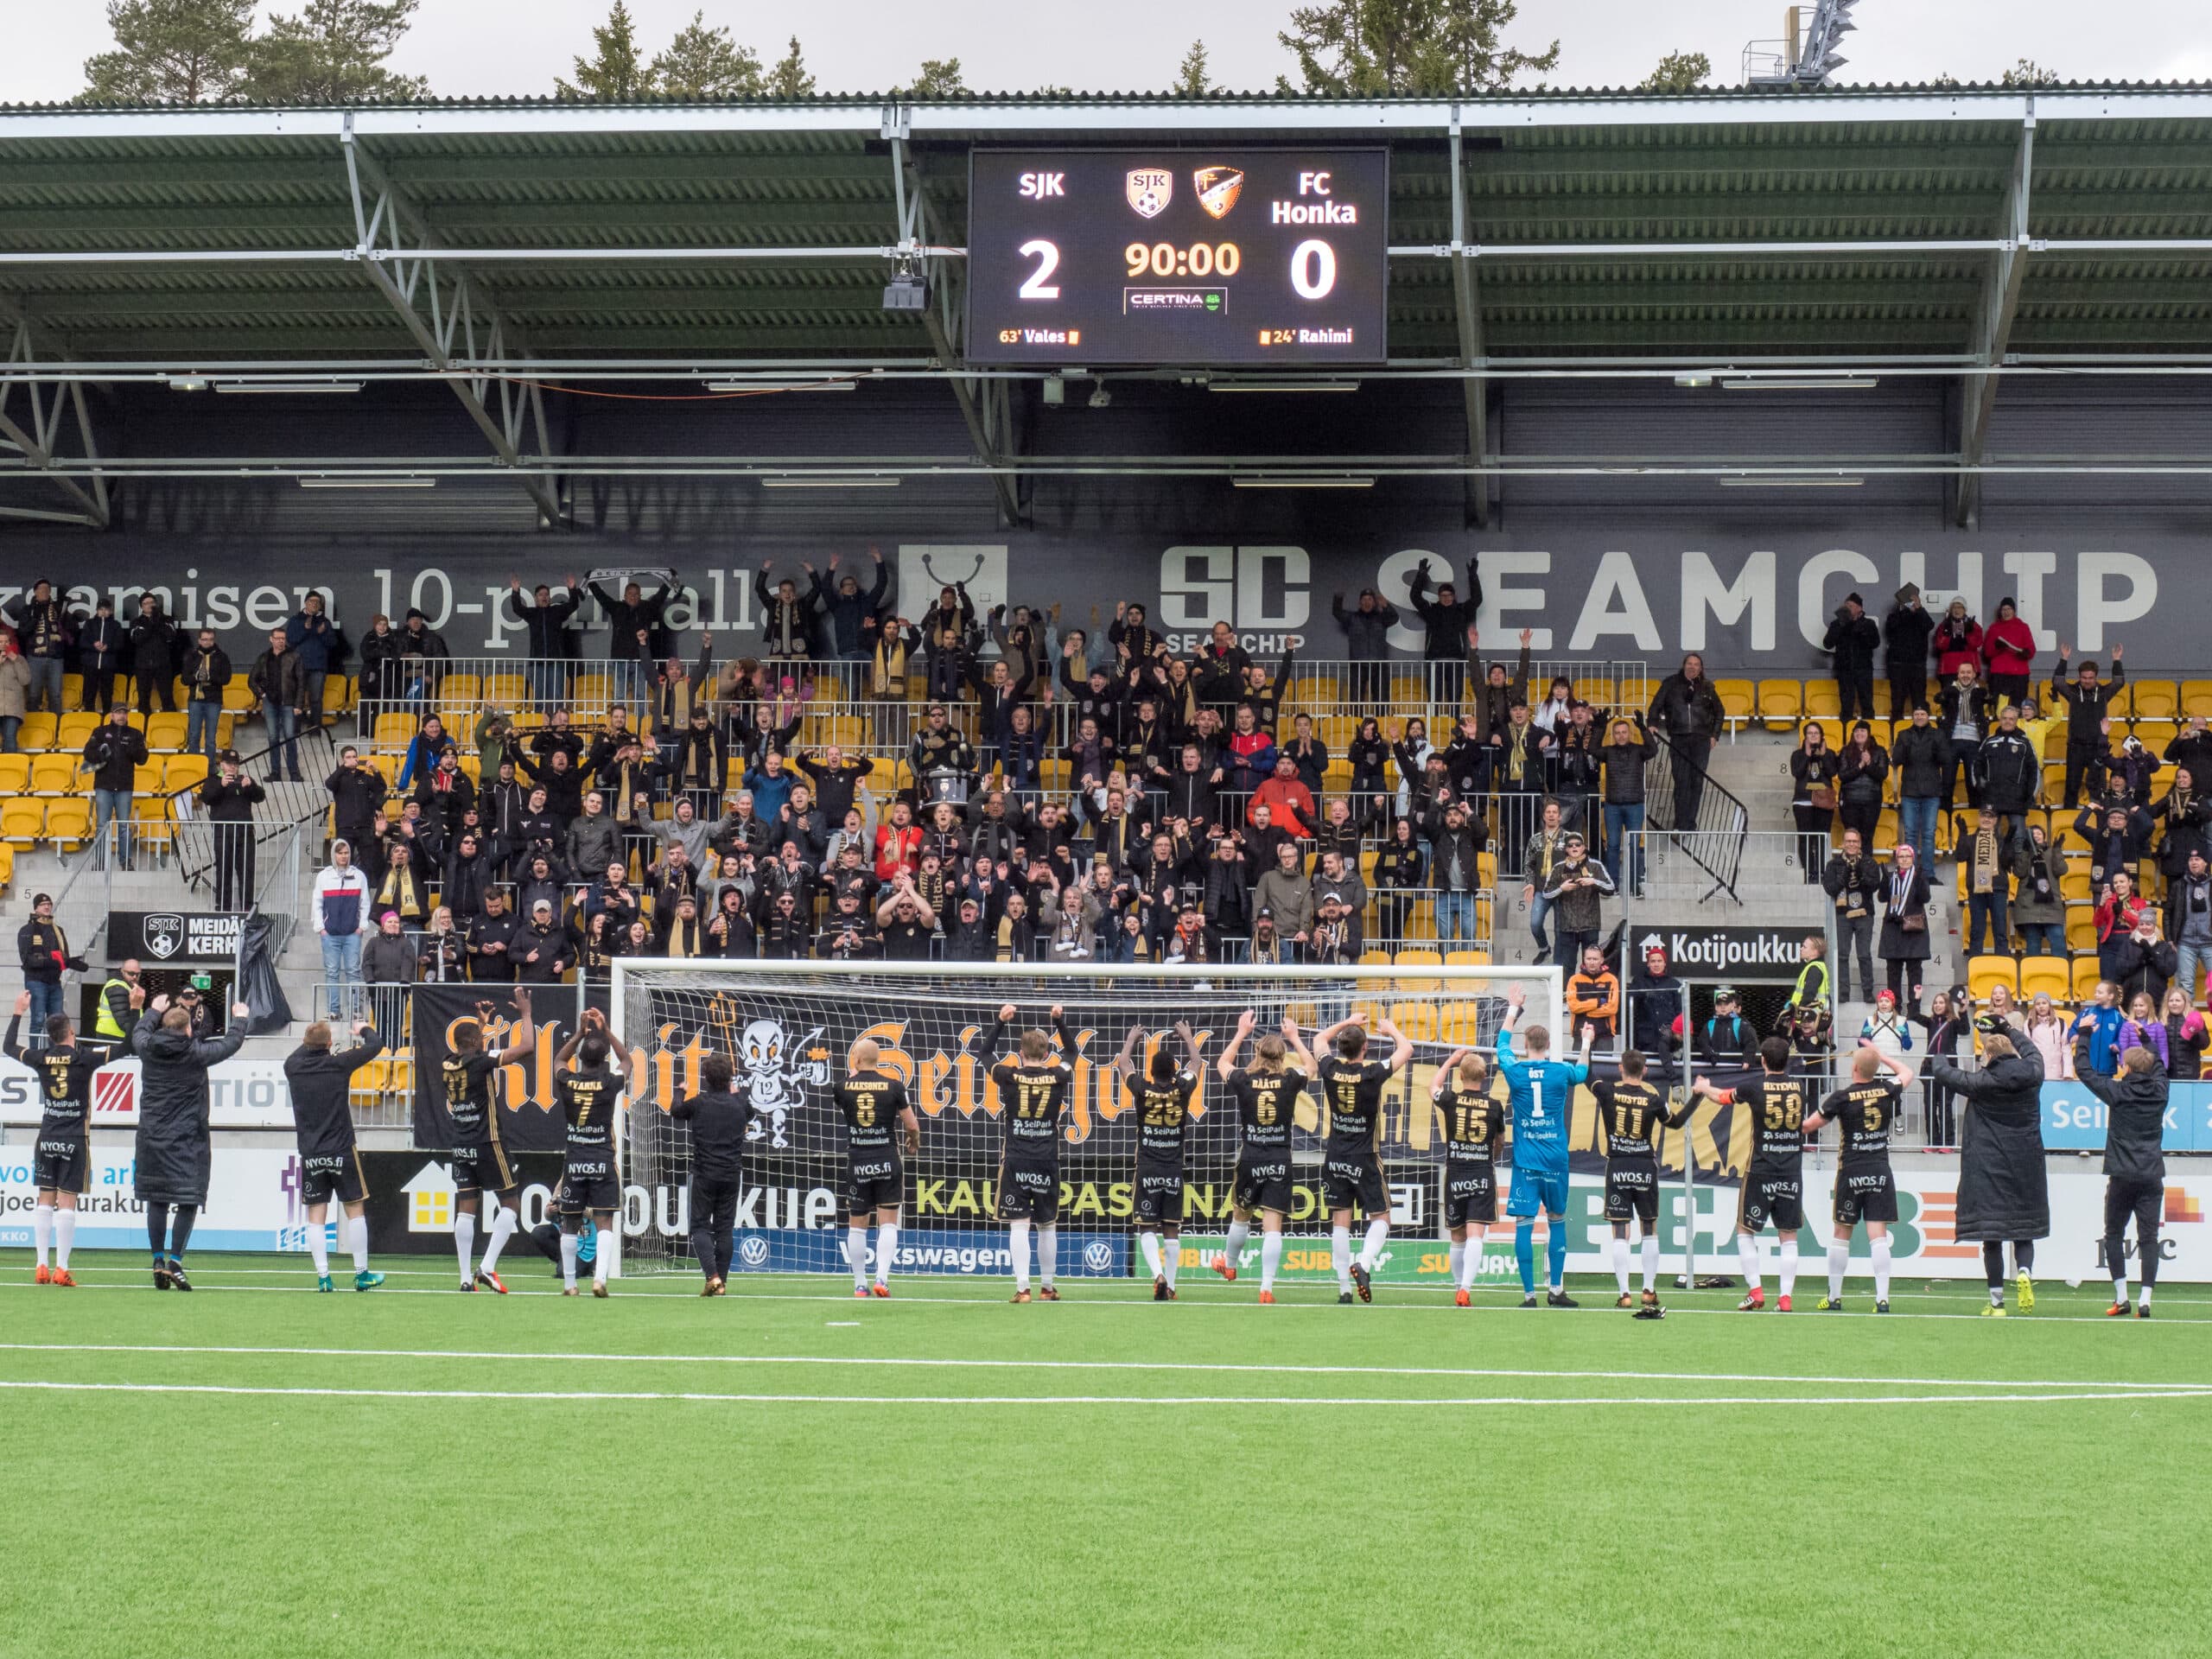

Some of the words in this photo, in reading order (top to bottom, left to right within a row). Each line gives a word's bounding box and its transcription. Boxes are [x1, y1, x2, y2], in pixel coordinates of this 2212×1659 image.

[1019, 173, 1065, 199] SJK
[1299, 172, 1331, 195] FC
[1272, 201, 1357, 225] Honka
[1019, 240, 1060, 299] 2
[1125, 243, 1241, 277] 90:00
[1290, 239, 1337, 300] 0
[1130, 294, 1204, 304] CERTINA
[1025, 329, 1065, 344] Vales
[1299, 328, 1352, 344] Rahimi
[1377, 550, 2158, 652] SEAMCHIP
[1166, 633, 1306, 654] SEACHIP
[1780, 763, 1788, 774] 8
[1783, 808, 1790, 819] 7
[1785, 855, 1794, 867] 6
[24, 888, 32, 899] 5
[1518, 899, 1526, 912] 5
[1929, 904, 1936, 916] 5
[149, 918, 179, 931] SJK
[188, 936, 238, 955] KERH
[1515, 949, 1522, 961] 4
[1672, 933, 1803, 969] Kotijoukku
[1934, 955, 1942, 965] 4
[50, 1065, 68, 1099] 3
[1529, 1067, 1545, 1079] ÖST
[574, 1092, 594, 1126] 7
[856, 1092, 875, 1127] 8
[1018, 1084, 1052, 1118] 17
[1257, 1090, 1277, 1125] 6
[1337, 1084, 1356, 1114] 9
[1457, 1096, 1490, 1109] KLINGA
[1530, 1082, 1545, 1117] 1
[1764, 1093, 1802, 1130] 58
[1454, 1107, 1489, 1143] 15
[1614, 1105, 1643, 1139] 11
[1863, 1098, 1882, 1131] 5
[839, 1241, 1013, 1273] Vokswagen
